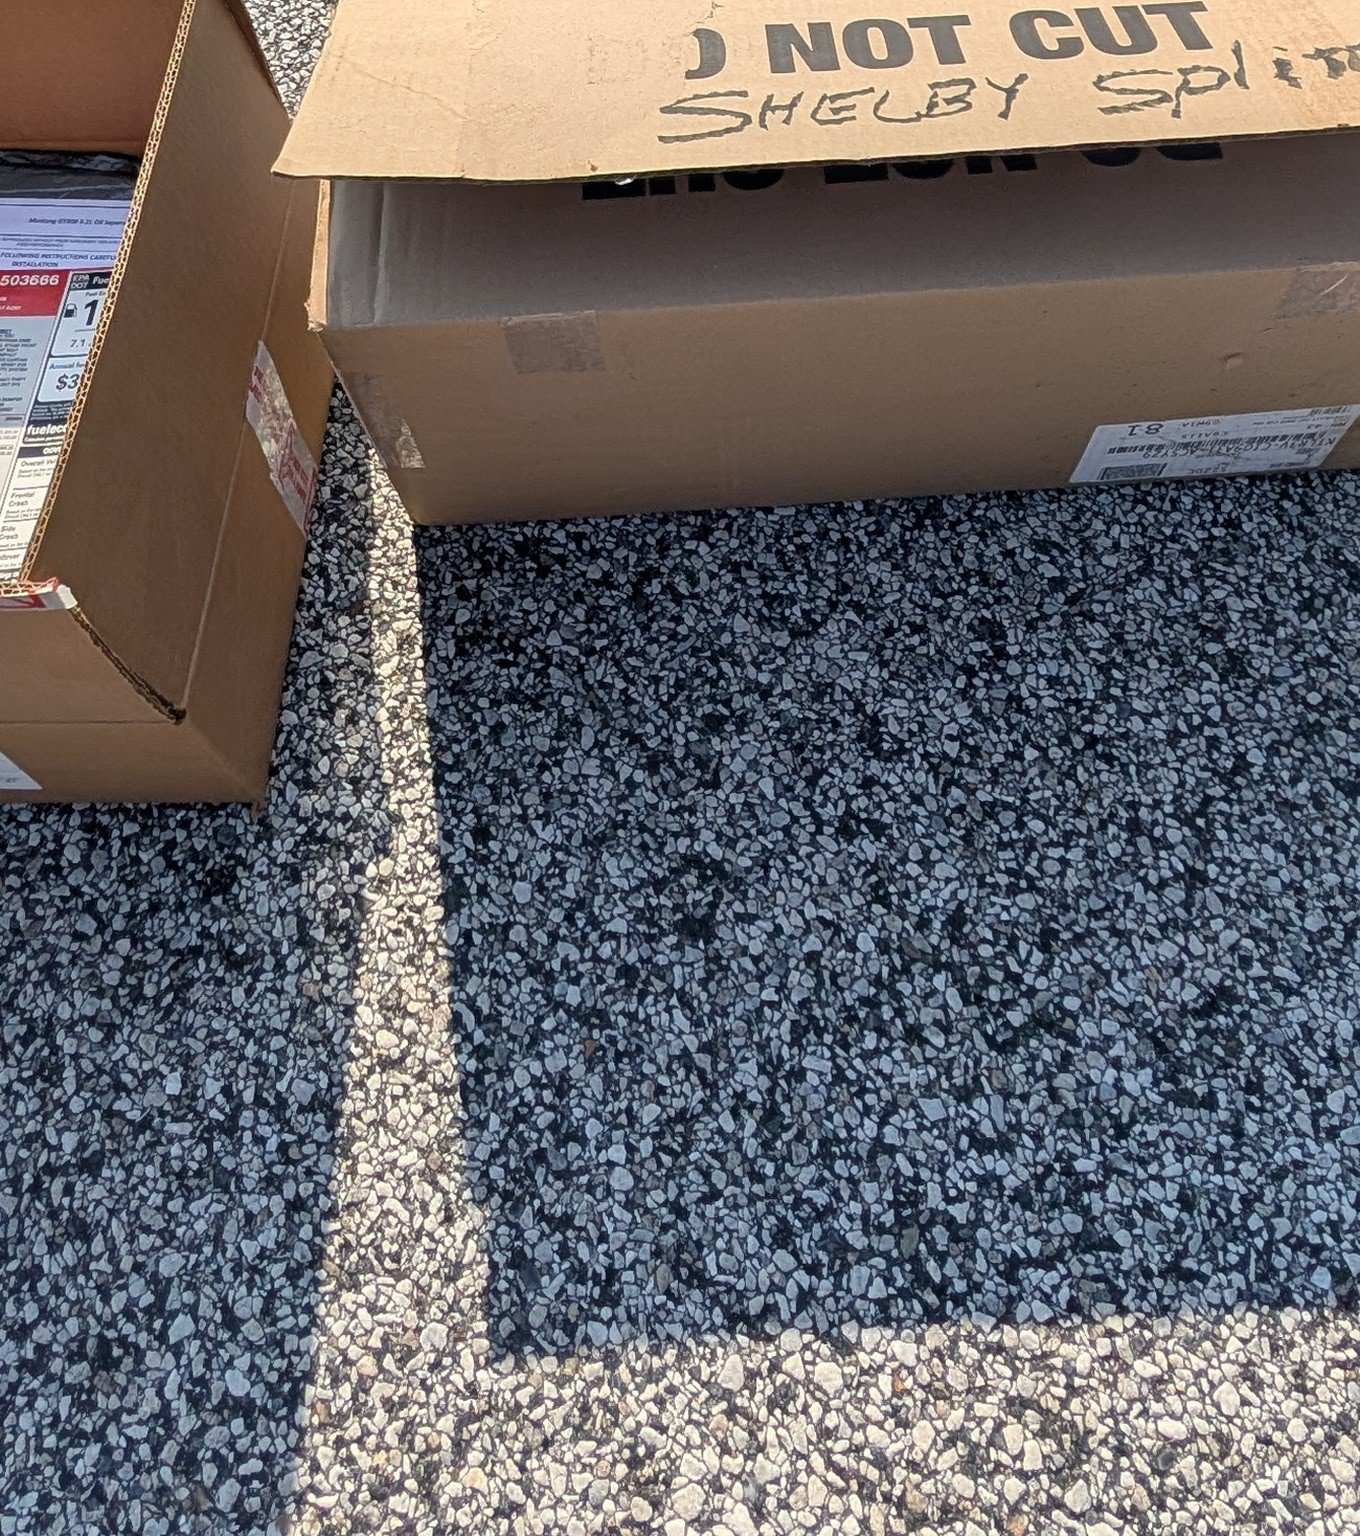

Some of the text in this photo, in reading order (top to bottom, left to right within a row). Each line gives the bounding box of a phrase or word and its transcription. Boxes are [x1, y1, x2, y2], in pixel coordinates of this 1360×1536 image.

[765, 14, 972, 75] NOT
[1008, 0, 1214, 61] CUT
[657, 72, 1029, 144] SHELBY
[0, 274, 60, 286] 503666
[55, 373, 80, 392] $3
[1128, 423, 1164, 436] 81
